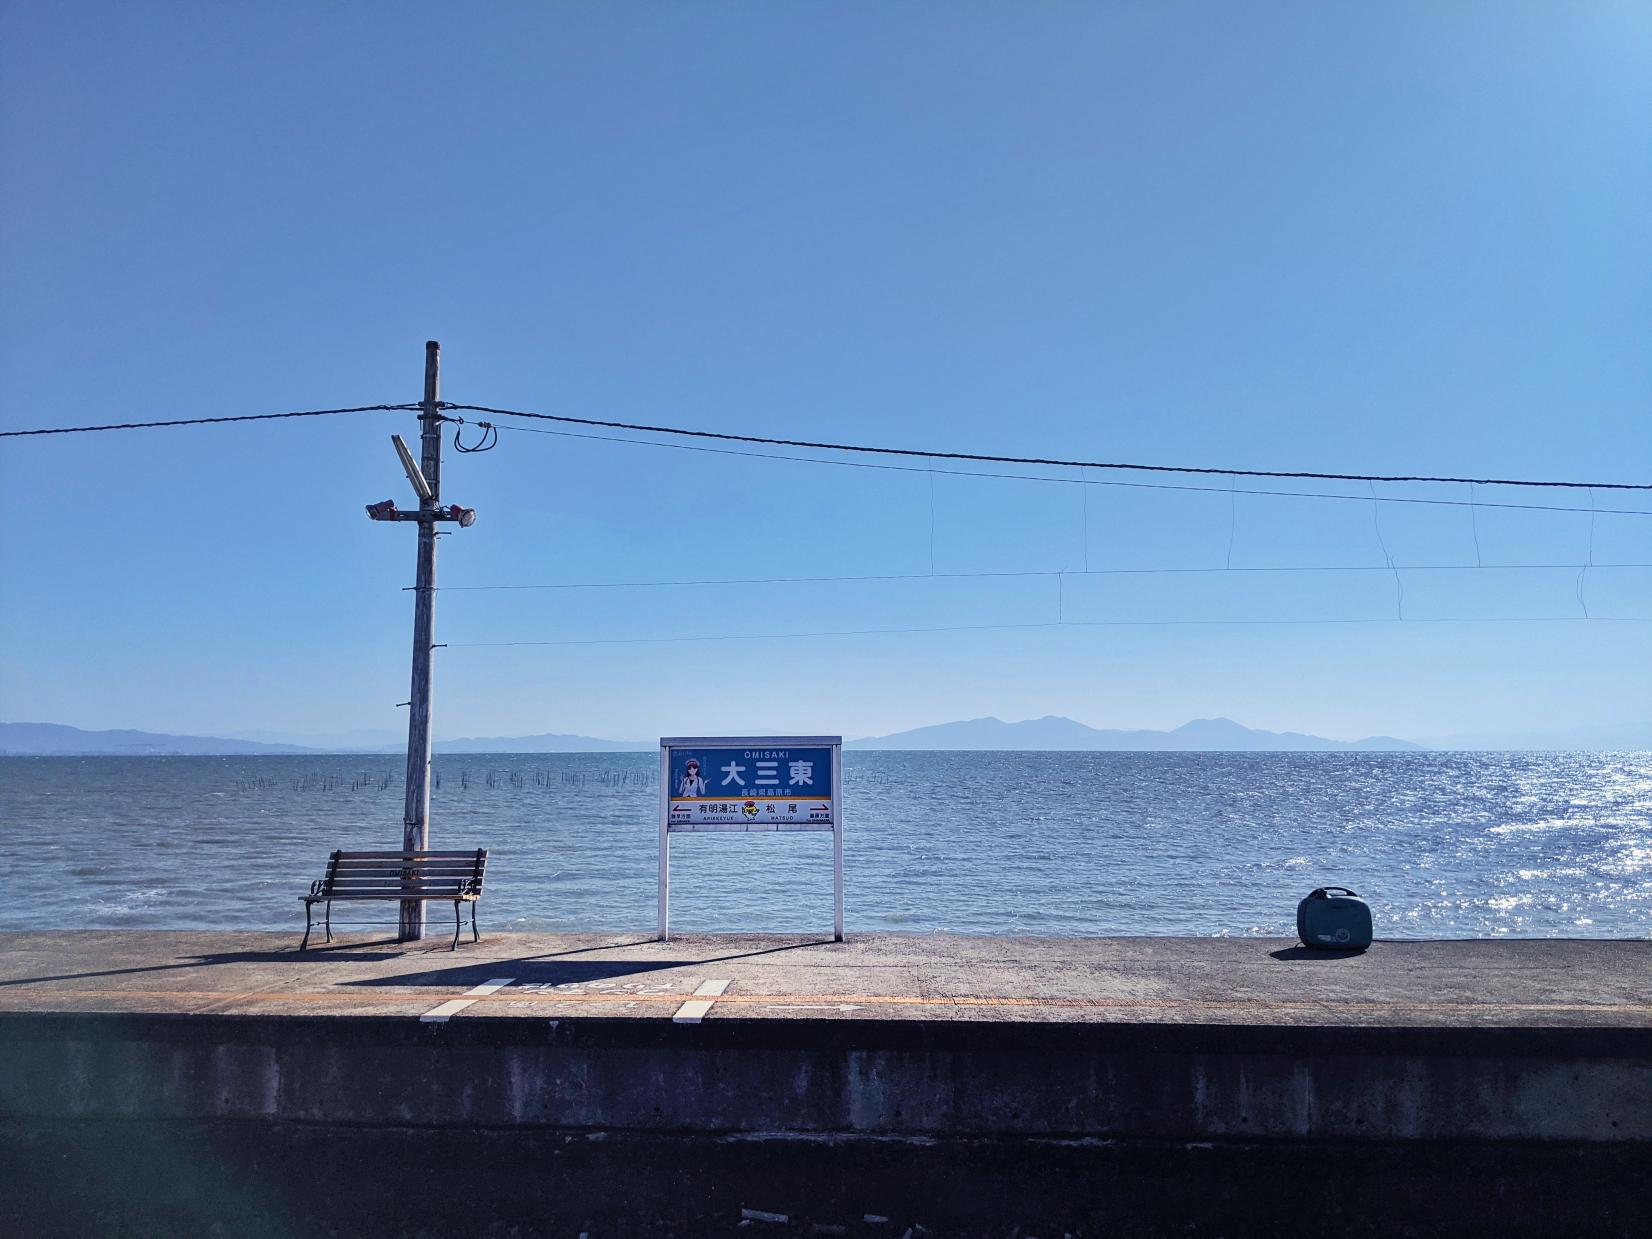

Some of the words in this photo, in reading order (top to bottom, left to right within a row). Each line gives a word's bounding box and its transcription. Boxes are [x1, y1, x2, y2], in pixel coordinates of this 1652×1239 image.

[721, 760, 814, 786] 大三東
[699, 803, 738, 813] 有明湯江
